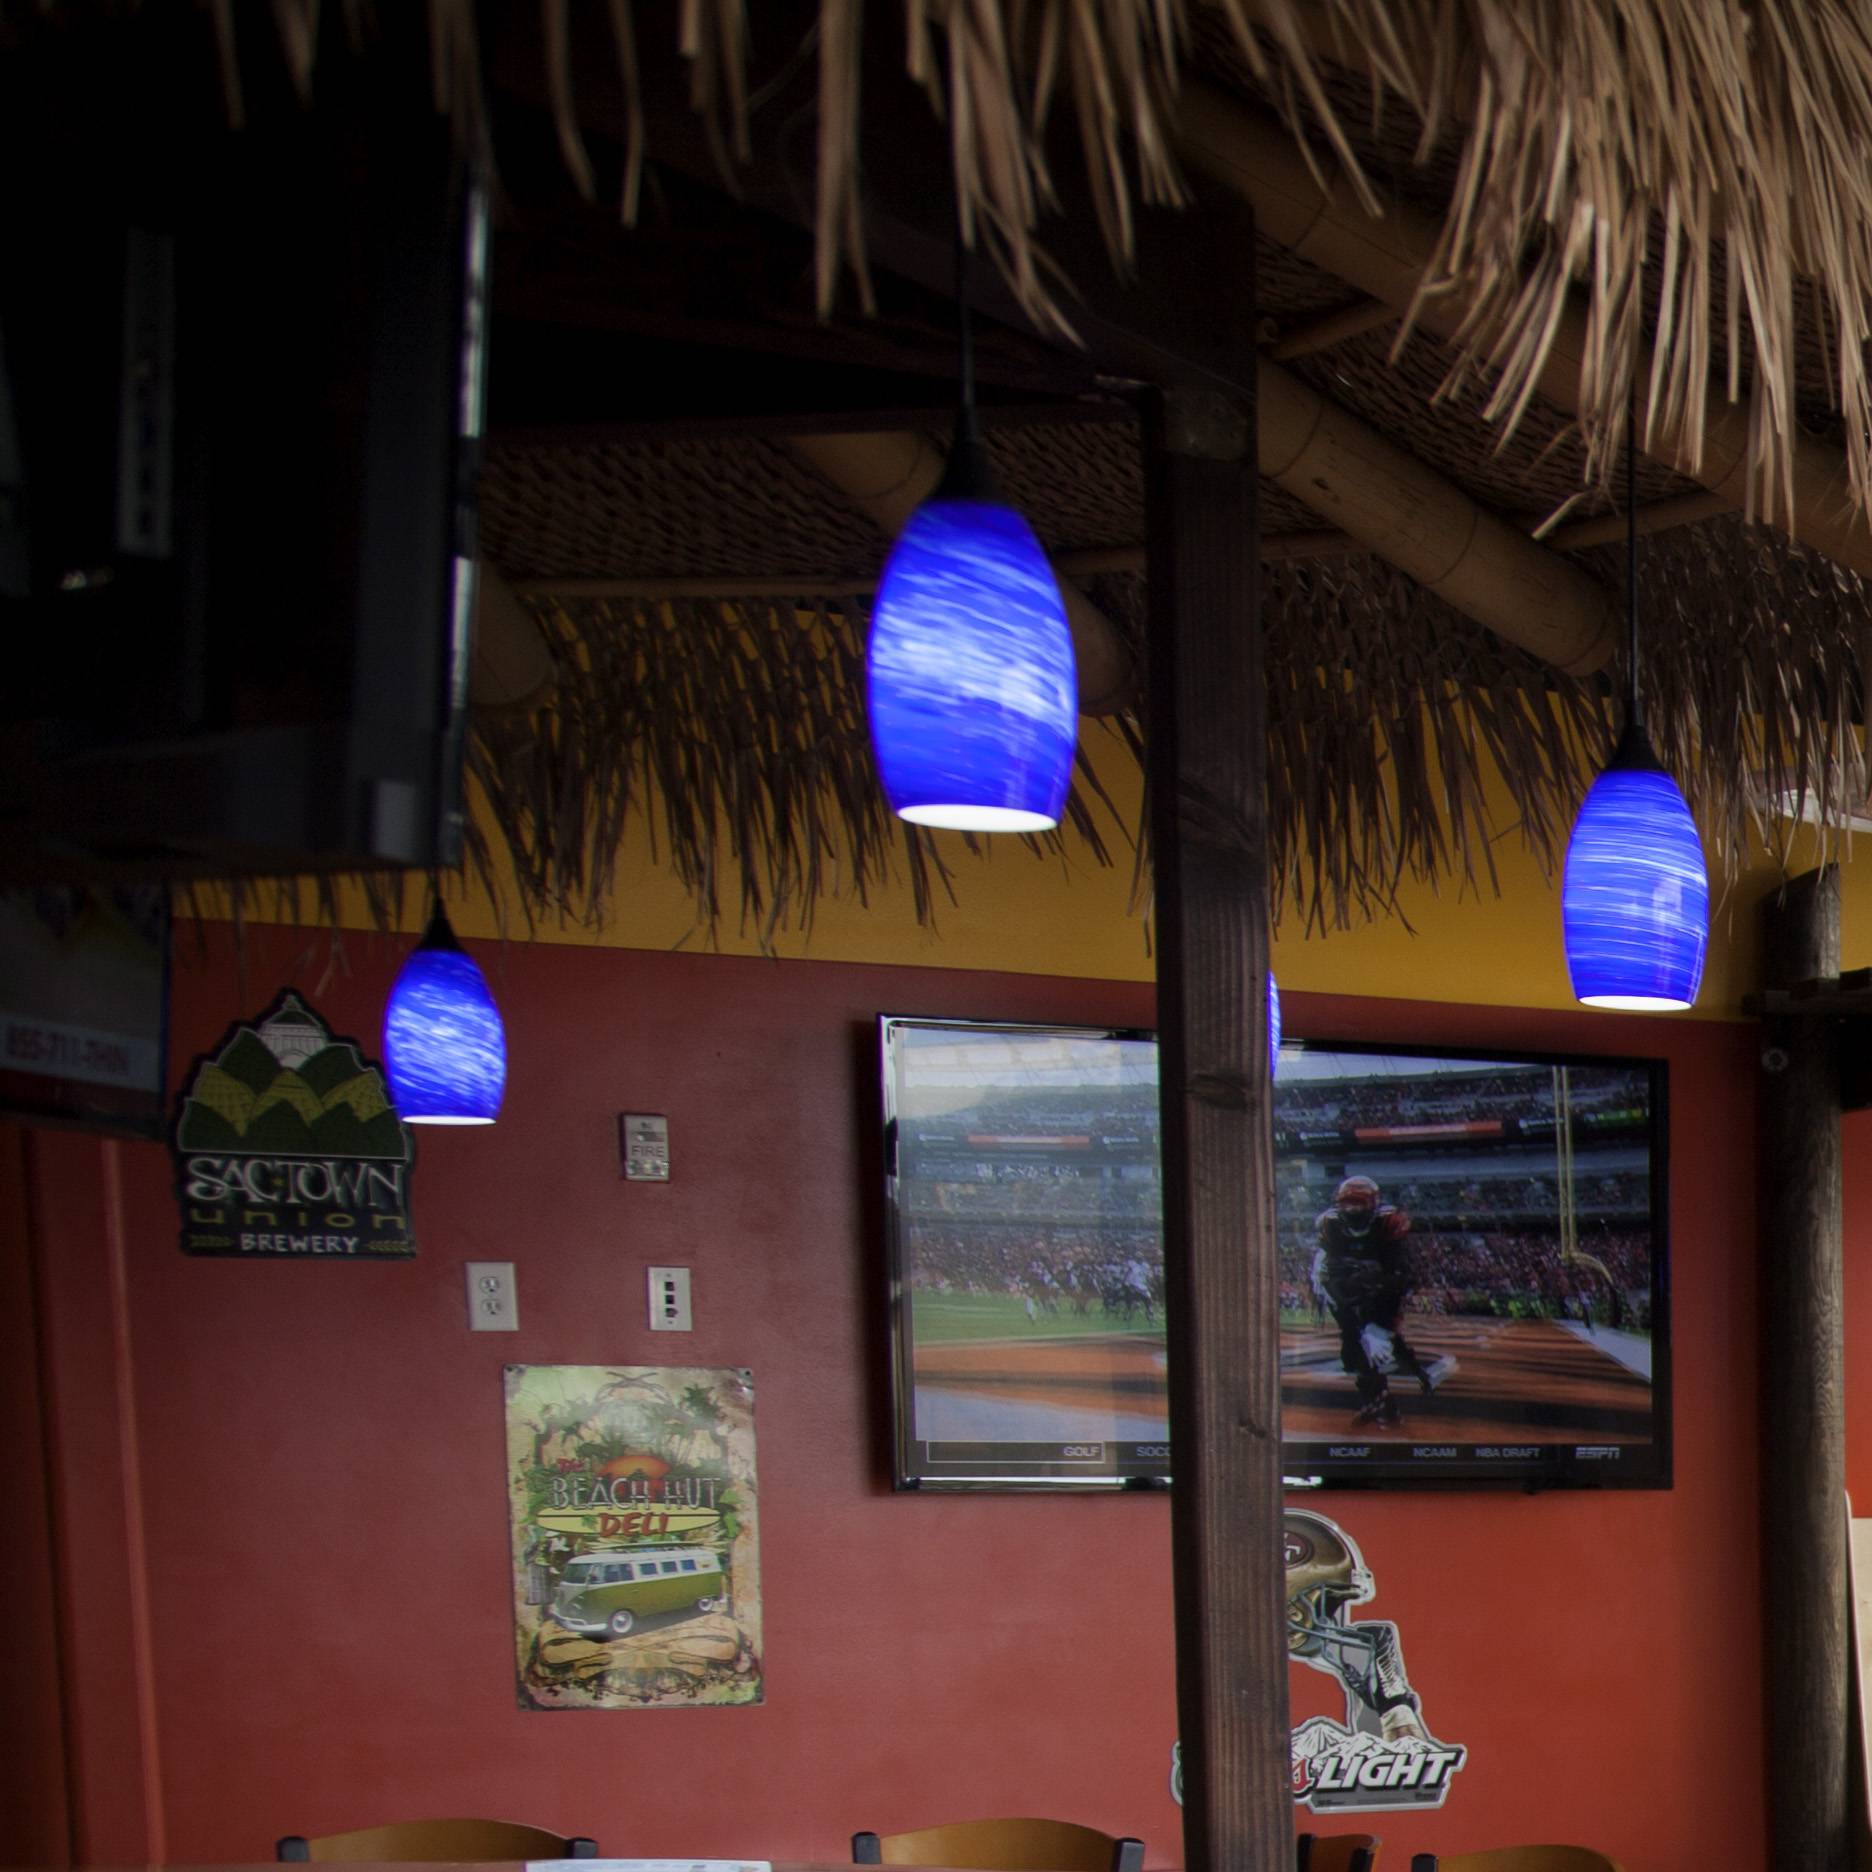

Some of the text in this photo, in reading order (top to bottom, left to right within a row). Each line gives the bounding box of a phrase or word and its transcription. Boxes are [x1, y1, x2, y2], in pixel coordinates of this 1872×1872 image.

[631, 1145, 664, 1157] FIRE
[192, 1208, 405, 1229] union
[240, 1233, 359, 1253] BREWERY
[1063, 1446, 1100, 1457] GOLF
[1329, 1446, 1371, 1457] NCAAF
[1413, 1447, 1457, 1458] NCAAM
[1475, 1447, 1540, 1458] NBA DRAFT
[1575, 1446, 1620, 1459] ESPN
[551, 1476, 721, 1510] BEACH HUT
[598, 1511, 669, 1537] DELI
[1316, 1751, 1458, 1790] LIGHT
